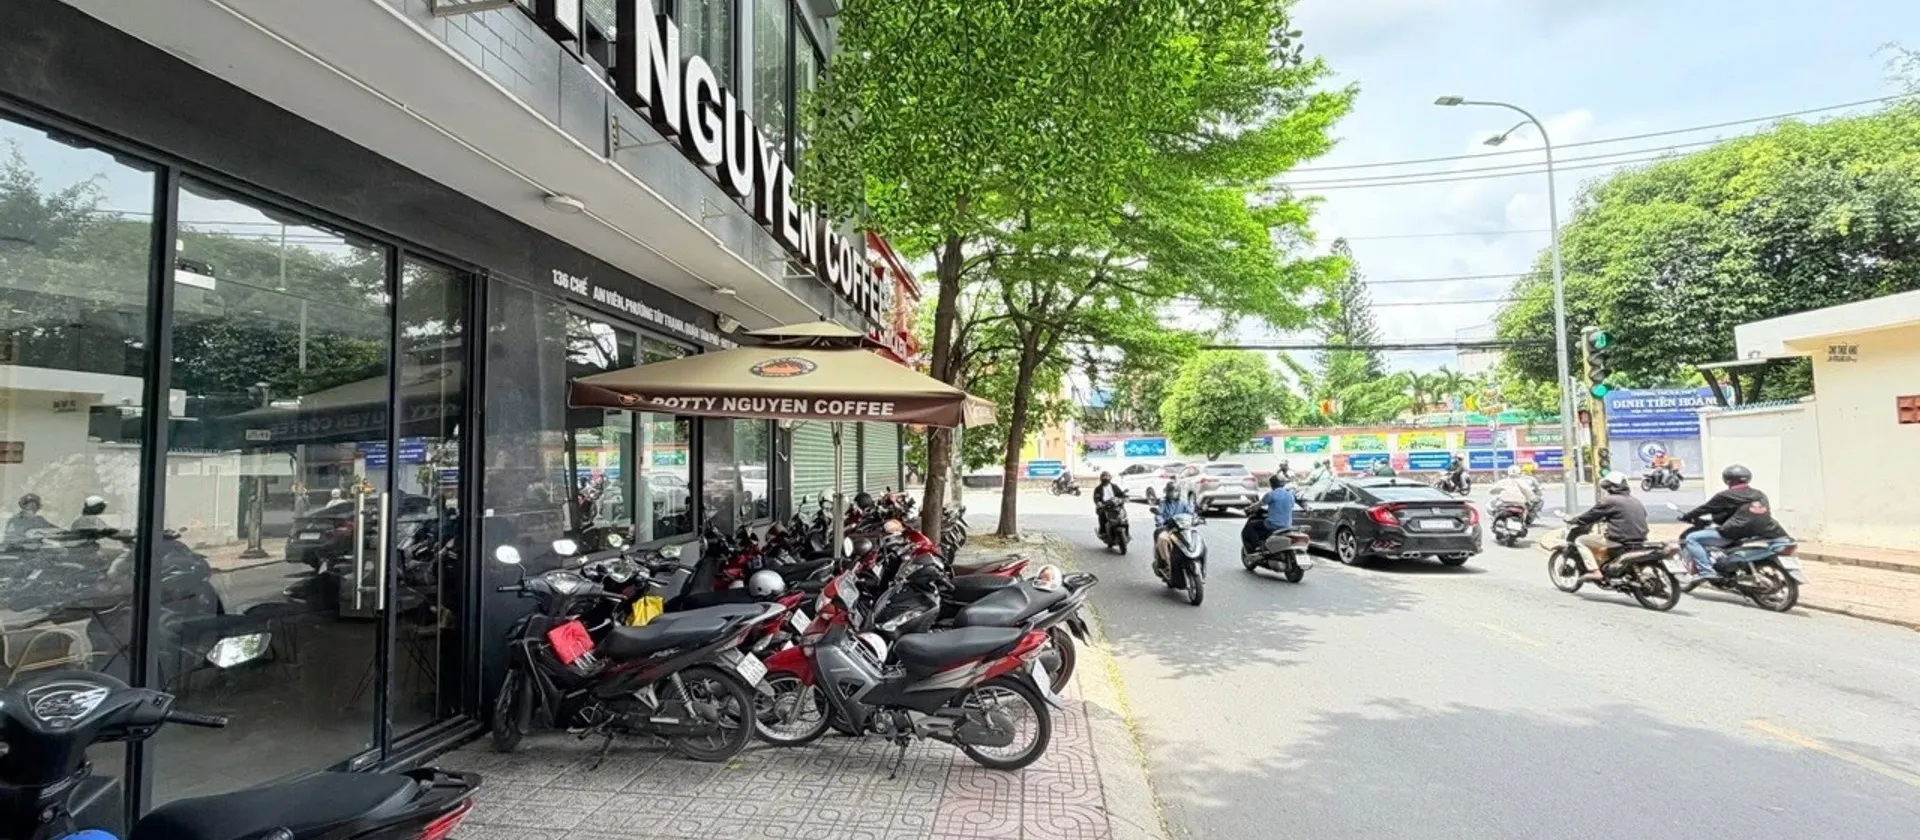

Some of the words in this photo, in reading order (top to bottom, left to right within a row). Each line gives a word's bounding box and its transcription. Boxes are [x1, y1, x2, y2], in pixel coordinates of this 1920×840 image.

[636, 0, 817, 268] NGUYEN
[825, 219, 888, 331] COFFEE
[552, 269, 569, 290] 136
[722, 397, 808, 414] NGUYEN
[814, 399, 895, 417] COFFEE
